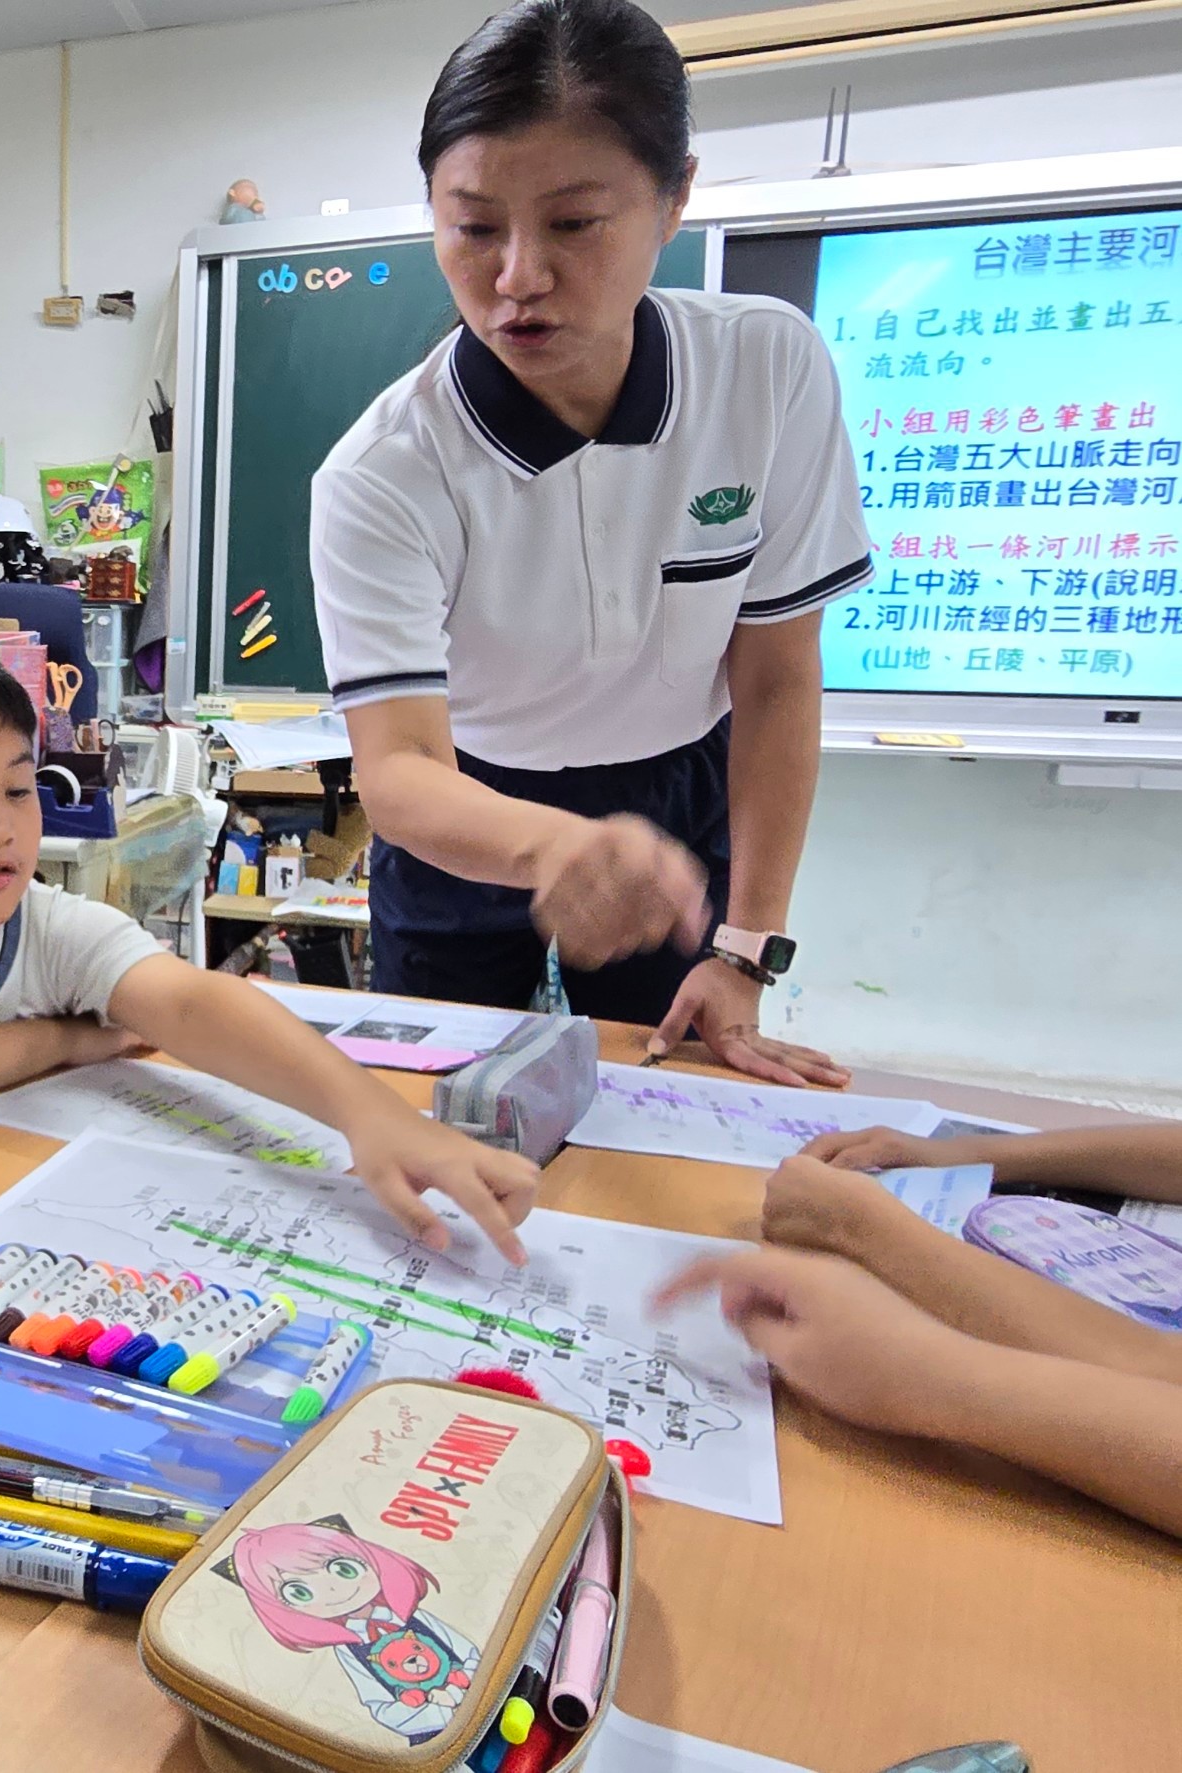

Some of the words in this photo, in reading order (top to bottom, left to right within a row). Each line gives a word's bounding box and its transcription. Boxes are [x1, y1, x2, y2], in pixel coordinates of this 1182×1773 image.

[974, 225, 1181, 271] 台灣主要河
[834, 300, 1182, 341] 1.自己找出並畫出五
[865, 351, 992, 378] 流流向。
[860, 401, 1156, 438] 小組用彩色筆畫出
[863, 438, 1181, 473] 1.台灣五大山脈走向
[860, 476, 1182, 509] 2.用箭頭畫出台灣河
[871, 531, 1180, 561] 組找一條河川標示
[853, 568, 1182, 600] .上中游、下游(說明
[862, 646, 1133, 678] (山地、丘陵、平原)
[1053, 1239, 1144, 1269] Kuromi
[416, 1413, 520, 1485] FAMILY
[380, 1481, 470, 1541] SPY
[41, 1540, 71, 1555] PILOT
